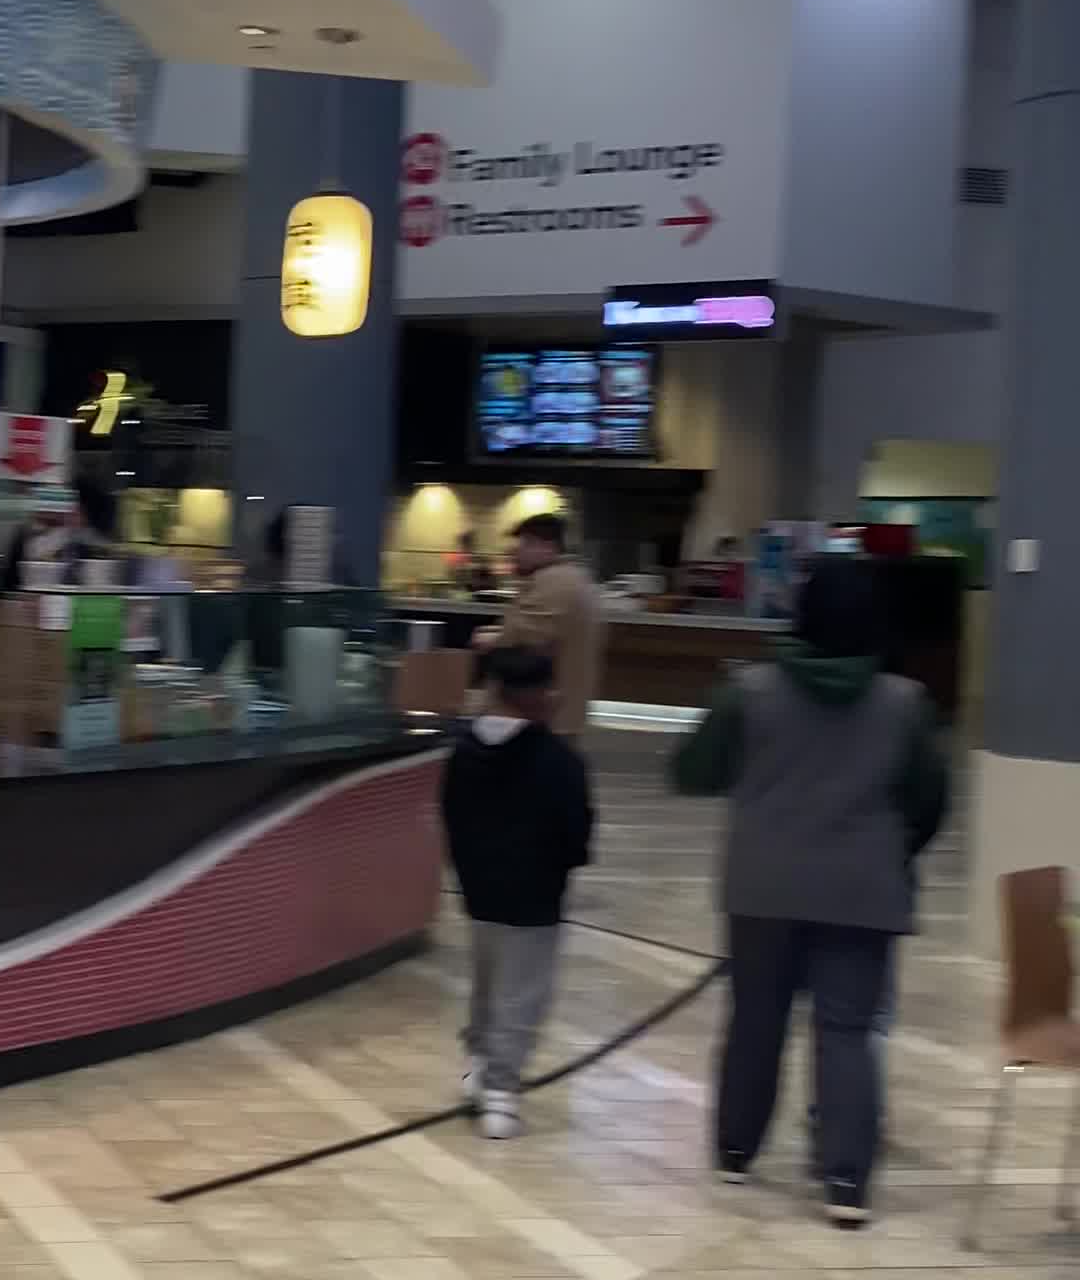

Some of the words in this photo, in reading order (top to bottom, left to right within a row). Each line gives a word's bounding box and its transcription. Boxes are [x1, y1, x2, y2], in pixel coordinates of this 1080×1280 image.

[446, 142, 566, 187] Family
[574, 141, 724, 180] Lounge
[444, 203, 645, 237] Restrooms
